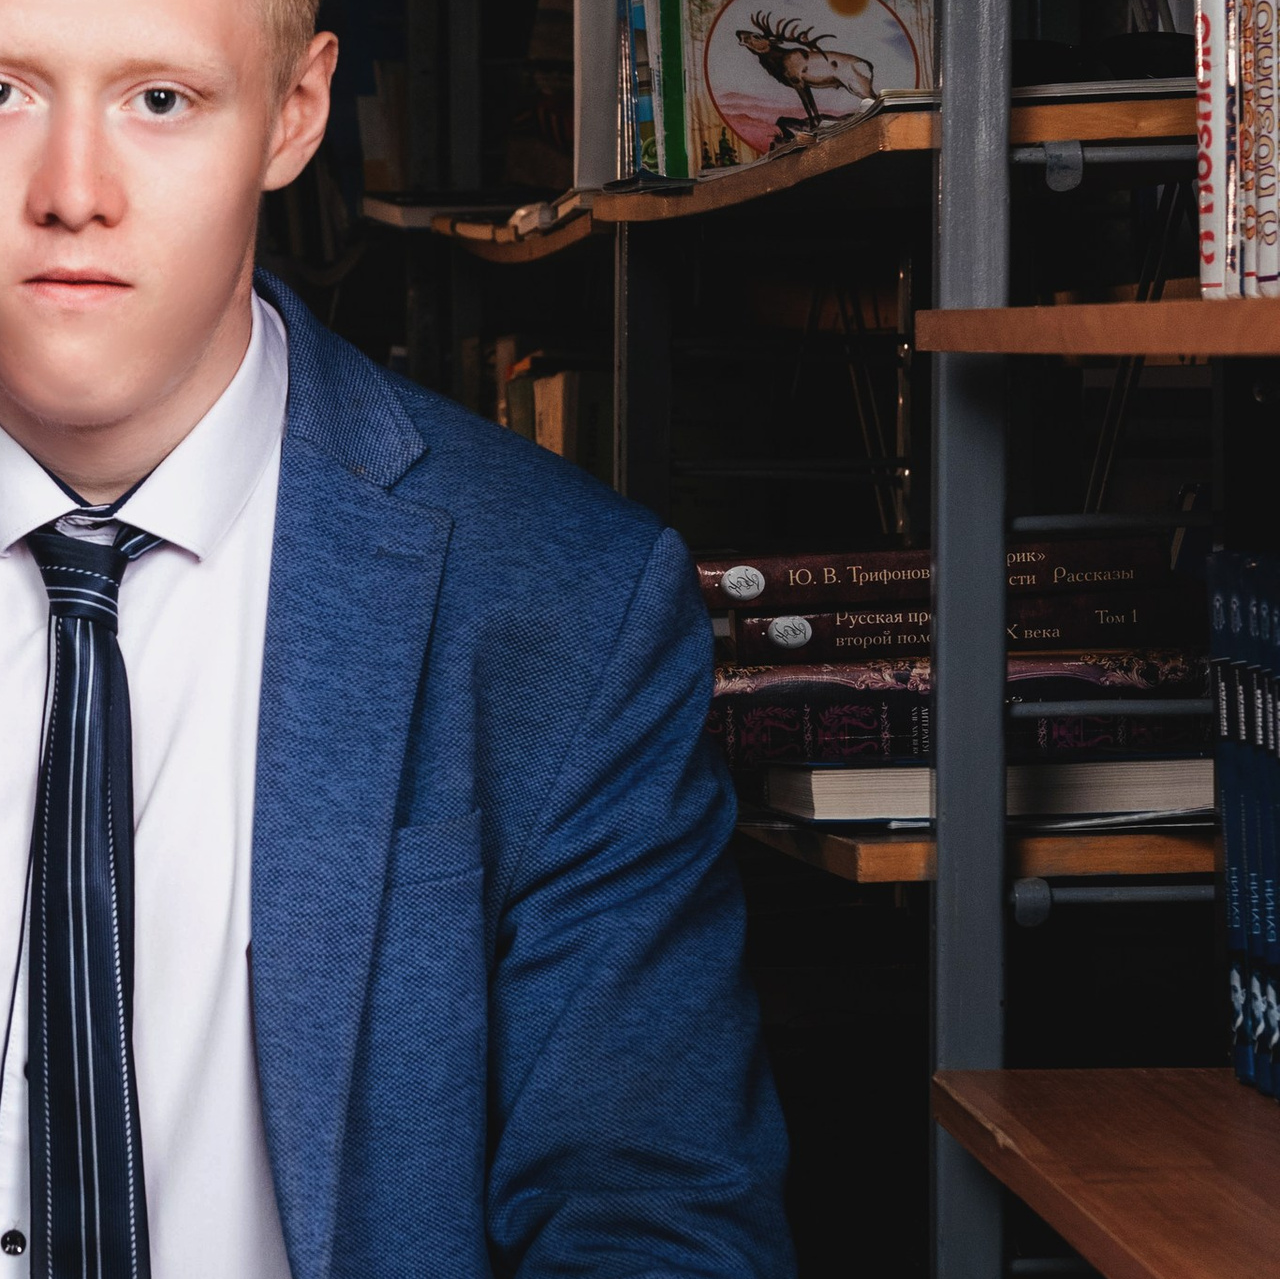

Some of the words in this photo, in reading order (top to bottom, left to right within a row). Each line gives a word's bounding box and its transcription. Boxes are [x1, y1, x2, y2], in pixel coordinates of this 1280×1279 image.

[788, 568, 817, 586] Ю.
[823, 567, 841, 585] В.
[846, 565, 931, 586] Трифонов
[1052, 566, 1135, 584] Рассказы
[836, 611, 903, 629] Русская
[1094, 609, 1126, 624] Том
[836, 630, 892, 649] второй
[1024, 627, 1061, 640] века
